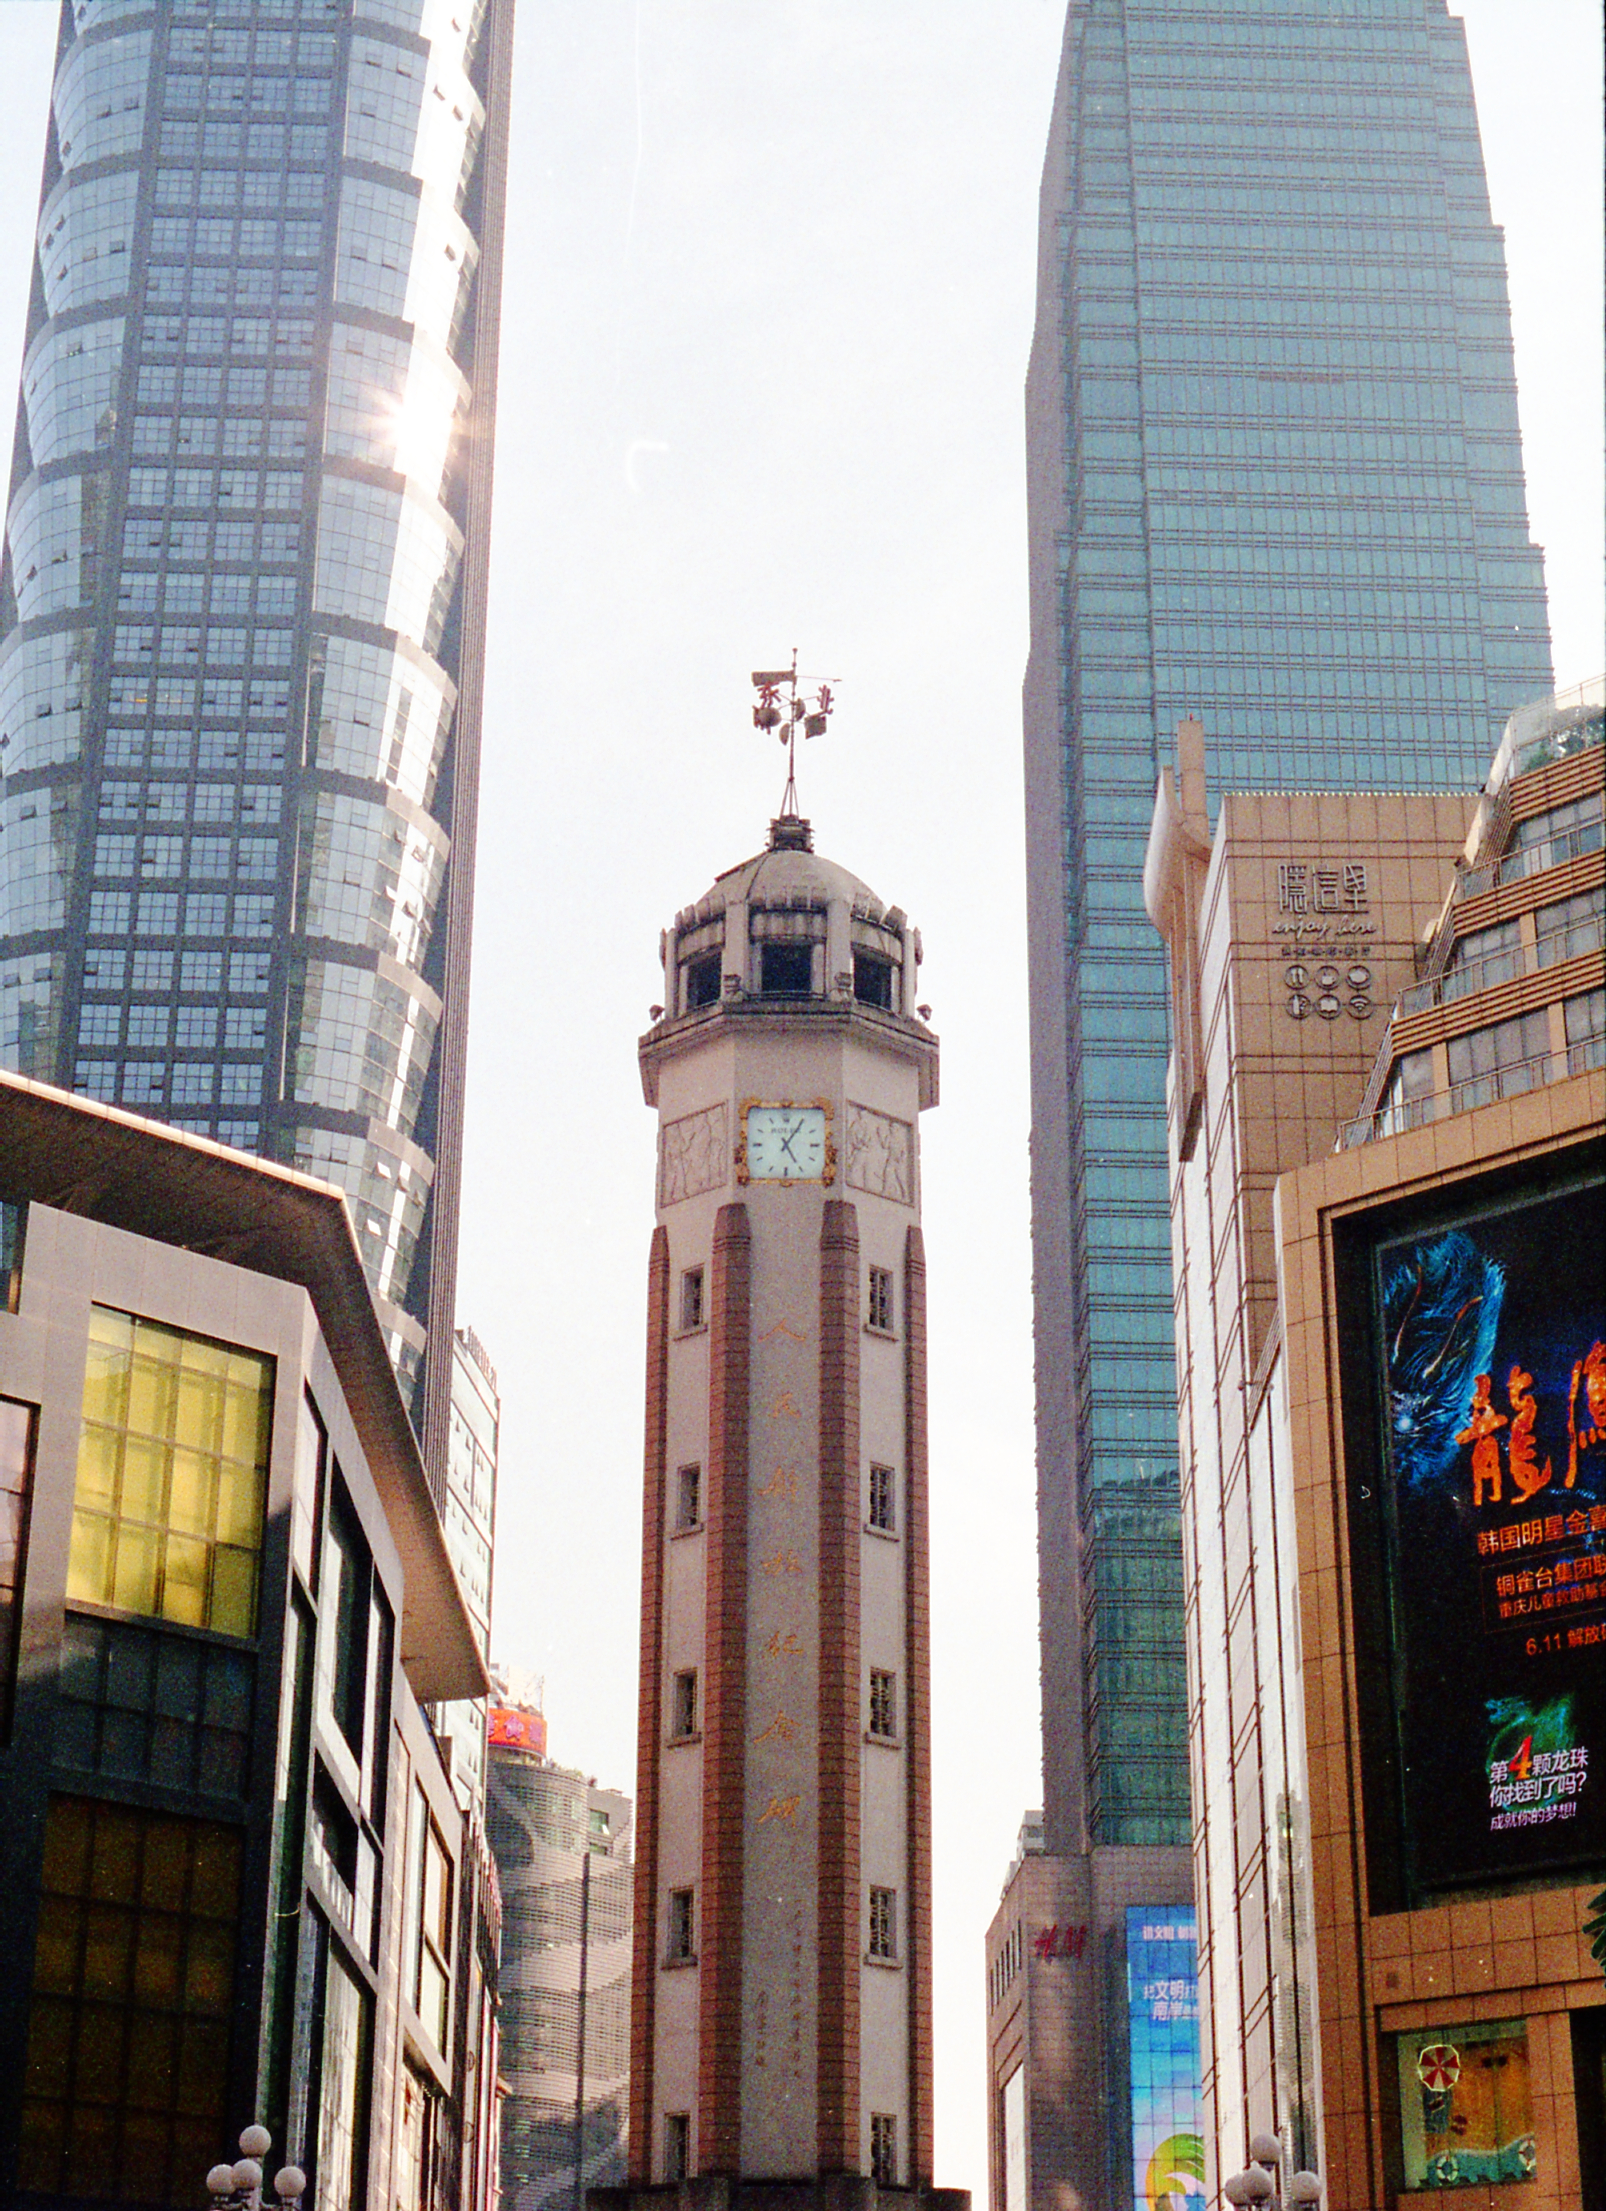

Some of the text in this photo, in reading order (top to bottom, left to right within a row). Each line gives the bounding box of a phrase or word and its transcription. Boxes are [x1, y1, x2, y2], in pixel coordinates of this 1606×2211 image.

[1526, 1633, 1561, 1656] 6.11
[1489, 1735, 1589, 1784] 第4颗龙珠
[1489, 1771, 1588, 1808] 你找到了吗?
[1490, 1801, 1577, 1831] 成就你的梦想!
